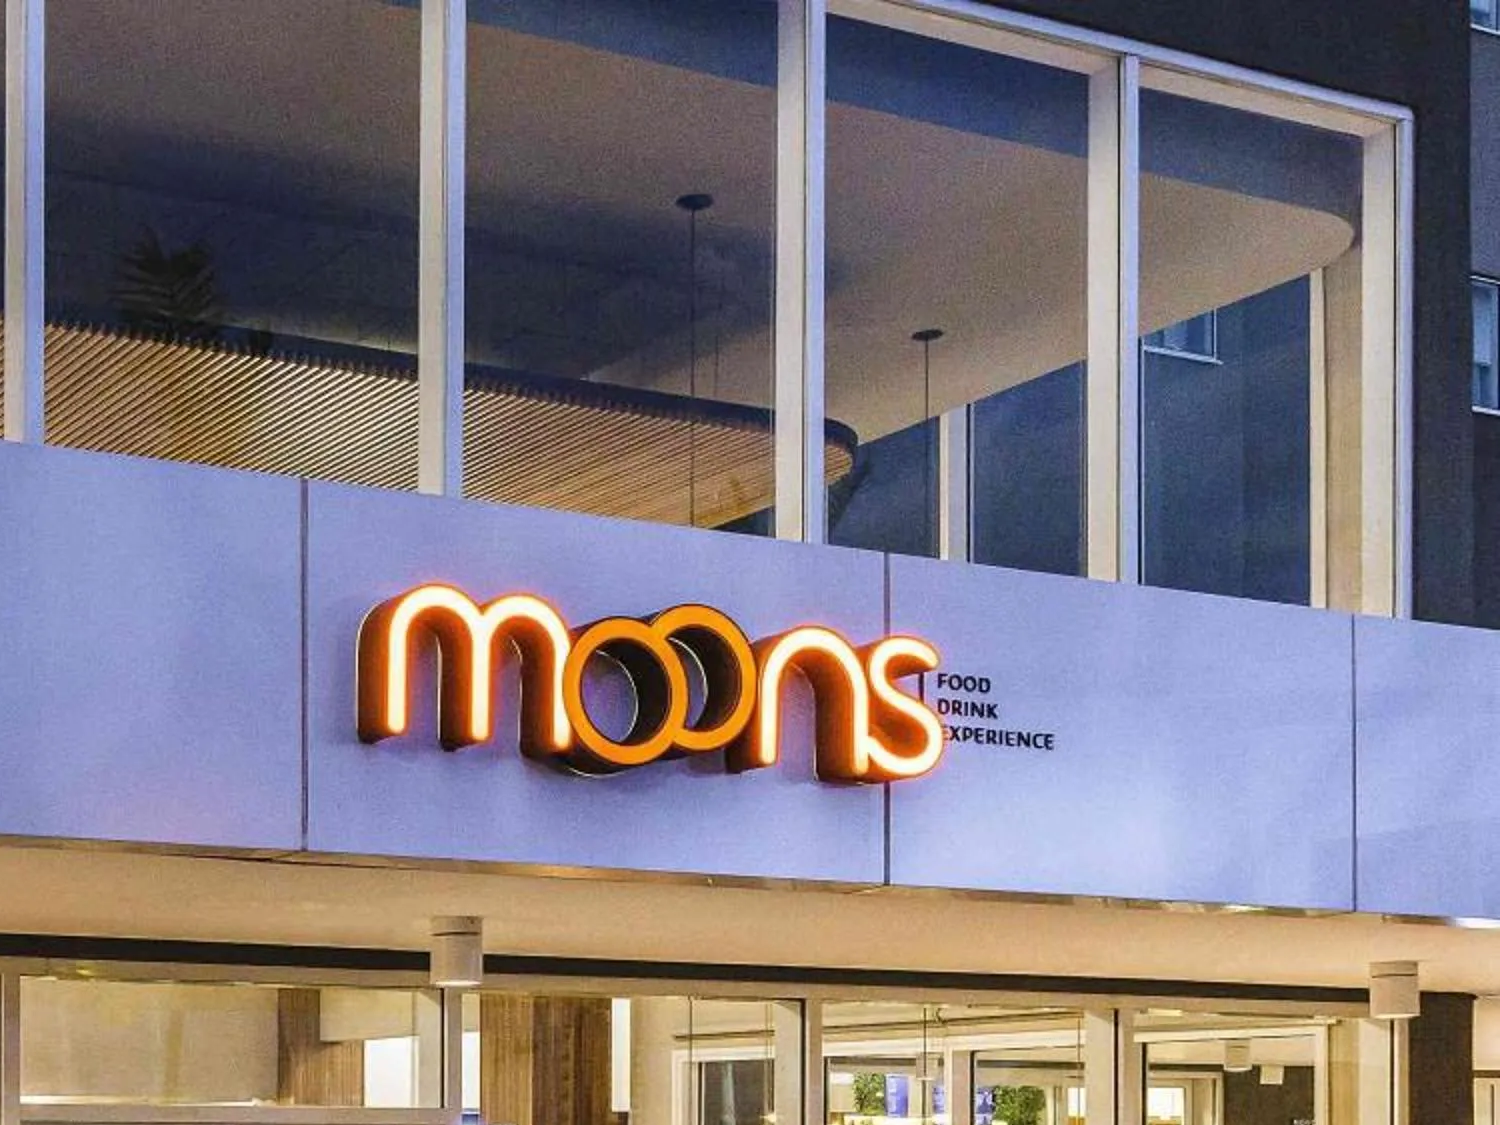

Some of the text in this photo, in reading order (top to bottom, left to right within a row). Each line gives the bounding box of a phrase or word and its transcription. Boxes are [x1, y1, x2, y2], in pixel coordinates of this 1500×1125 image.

[357, 583, 943, 786] moons
[937, 673, 991, 693] FOOD
[937, 698, 998, 719] DRINK
